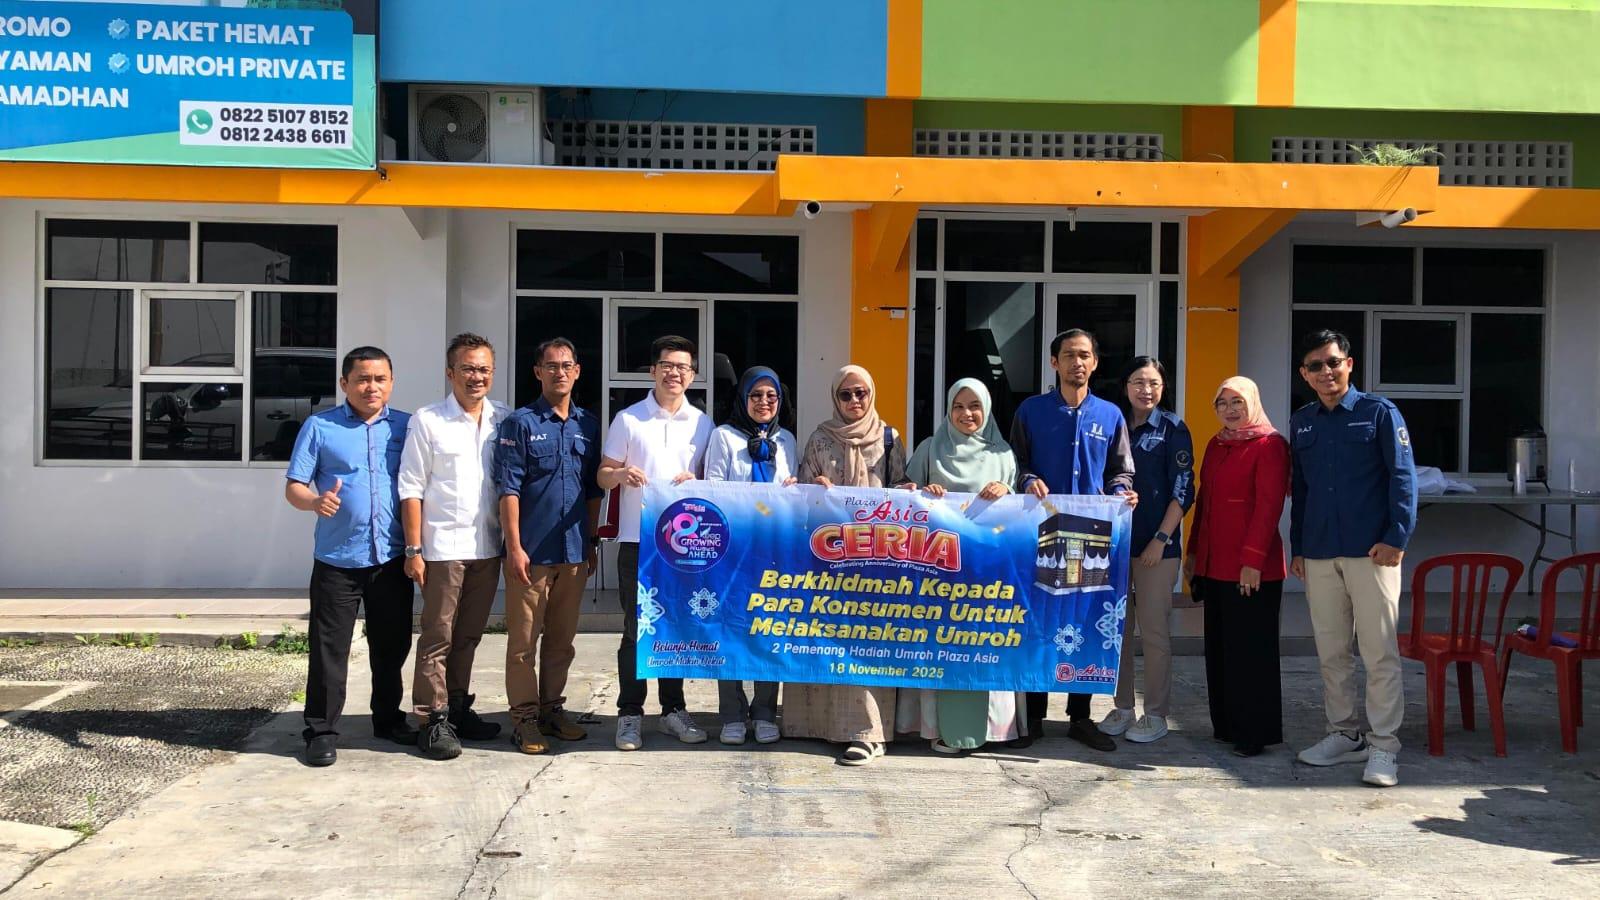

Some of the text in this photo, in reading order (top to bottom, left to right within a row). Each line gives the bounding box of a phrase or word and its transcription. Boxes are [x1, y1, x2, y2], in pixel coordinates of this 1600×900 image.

[136, 20, 314, 46] PAKET HEMAT
[136, 54, 346, 81] UMROH PRIVATE
[220, 107, 349, 126] 0822 5107 8152
[220, 127, 346, 145] 0812 2438 6611
[844, 497, 877, 507] Plaza
[854, 500, 929, 523] Asia
[680, 538, 721, 547] GROWING
[810, 522, 961, 572] CERIA
[688, 551, 718, 559] AHEAD
[829, 560, 864, 569] Celebrating
[864, 560, 901, 568] Anniversary
[908, 563, 925, 572] Plaza
[925, 567, 939, 576] Asia
[760, 569, 1015, 601] Berkhidmah Kepada
[747, 593, 1028, 624] Para Konsumen Untuk
[749, 617, 1022, 647] Melaksanakan Umroh
[771, 642, 1000, 664] 2 Pemenang Hadiah Umroh Plaza Asia
[829, 662, 944, 678] 18 November 2025
